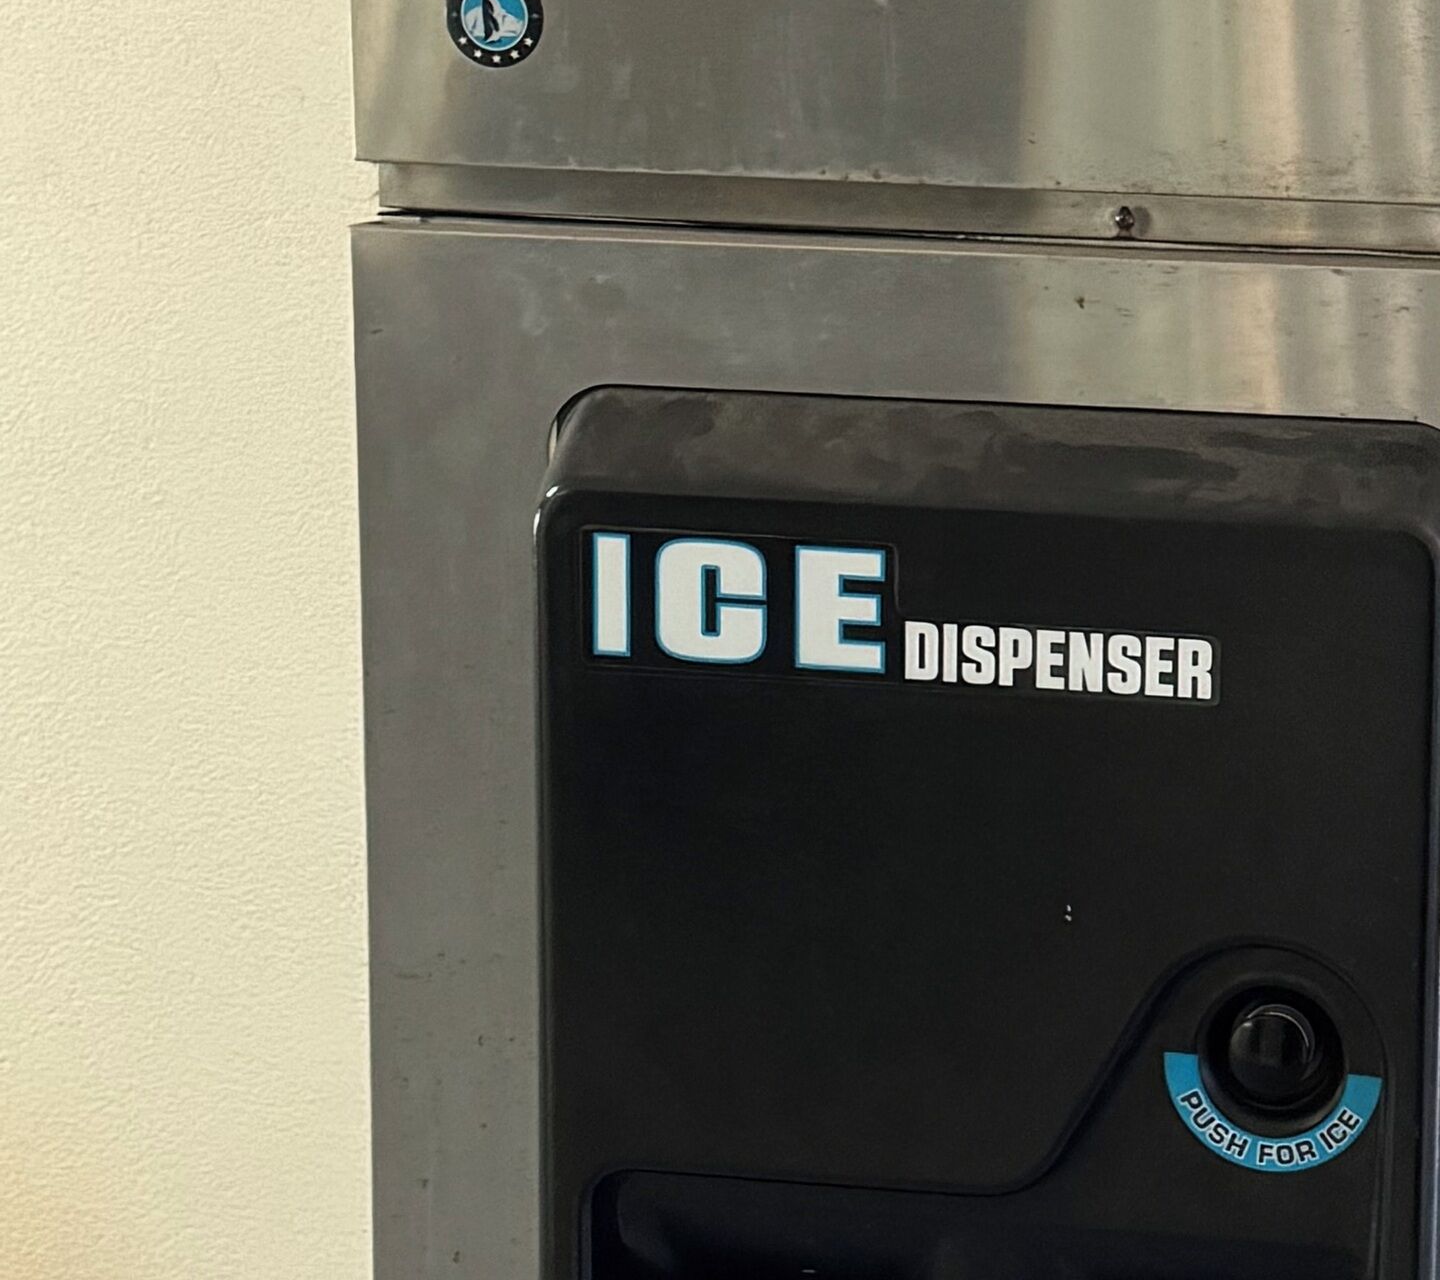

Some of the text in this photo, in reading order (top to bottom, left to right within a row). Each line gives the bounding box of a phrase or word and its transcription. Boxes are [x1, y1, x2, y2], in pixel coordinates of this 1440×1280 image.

[592, 531, 887, 674] ICE
[904, 620, 1212, 700] DISPENSER
[1179, 1088, 1363, 1165] PUSH FOR ICE
